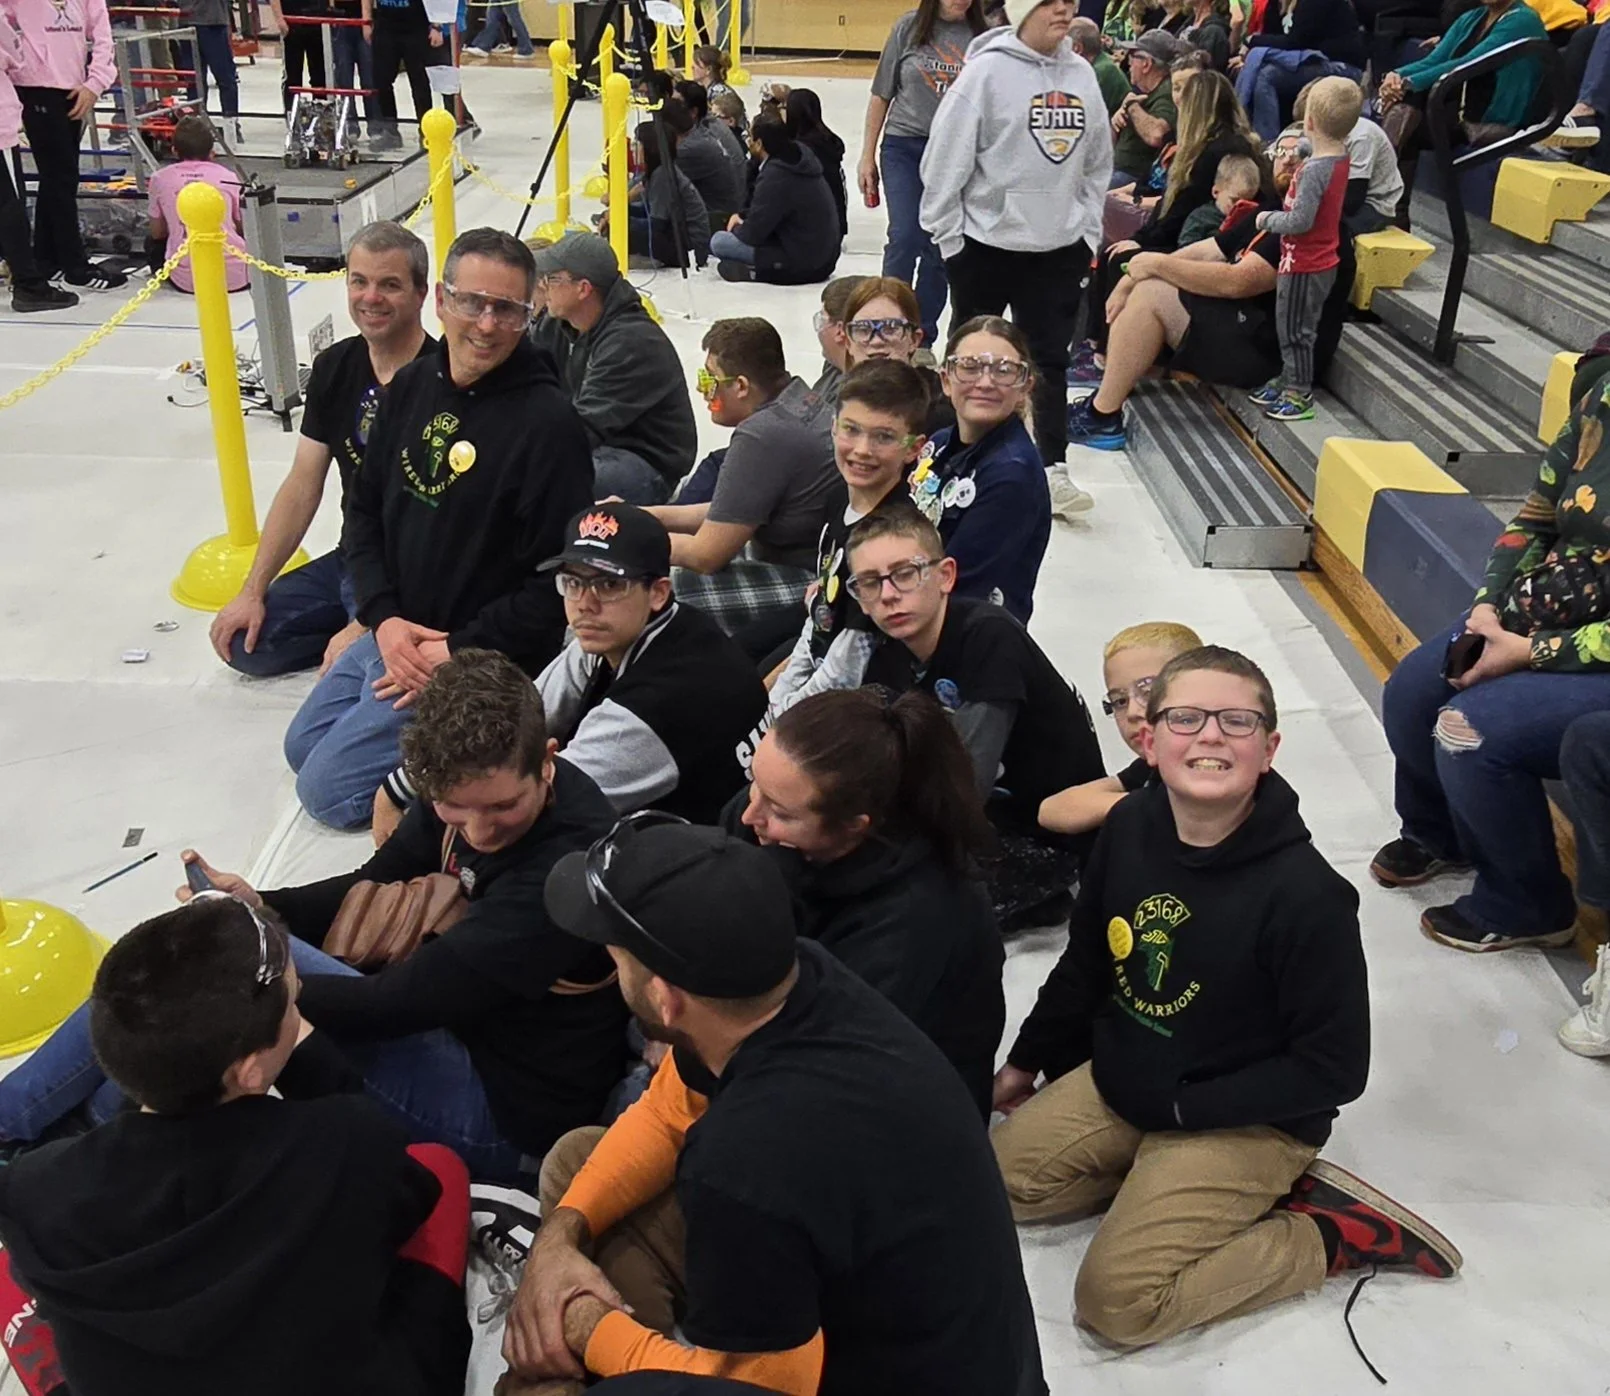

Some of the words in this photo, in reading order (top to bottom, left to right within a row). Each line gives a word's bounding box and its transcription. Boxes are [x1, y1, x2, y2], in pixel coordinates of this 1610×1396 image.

[1031, 107, 1084, 128] STATE
[344, 437, 361, 465] WIRE
[1136, 898, 1184, 927] 23168
[1114, 957, 1132, 997] RED
[1133, 980, 1202, 1018] WARRIORS
